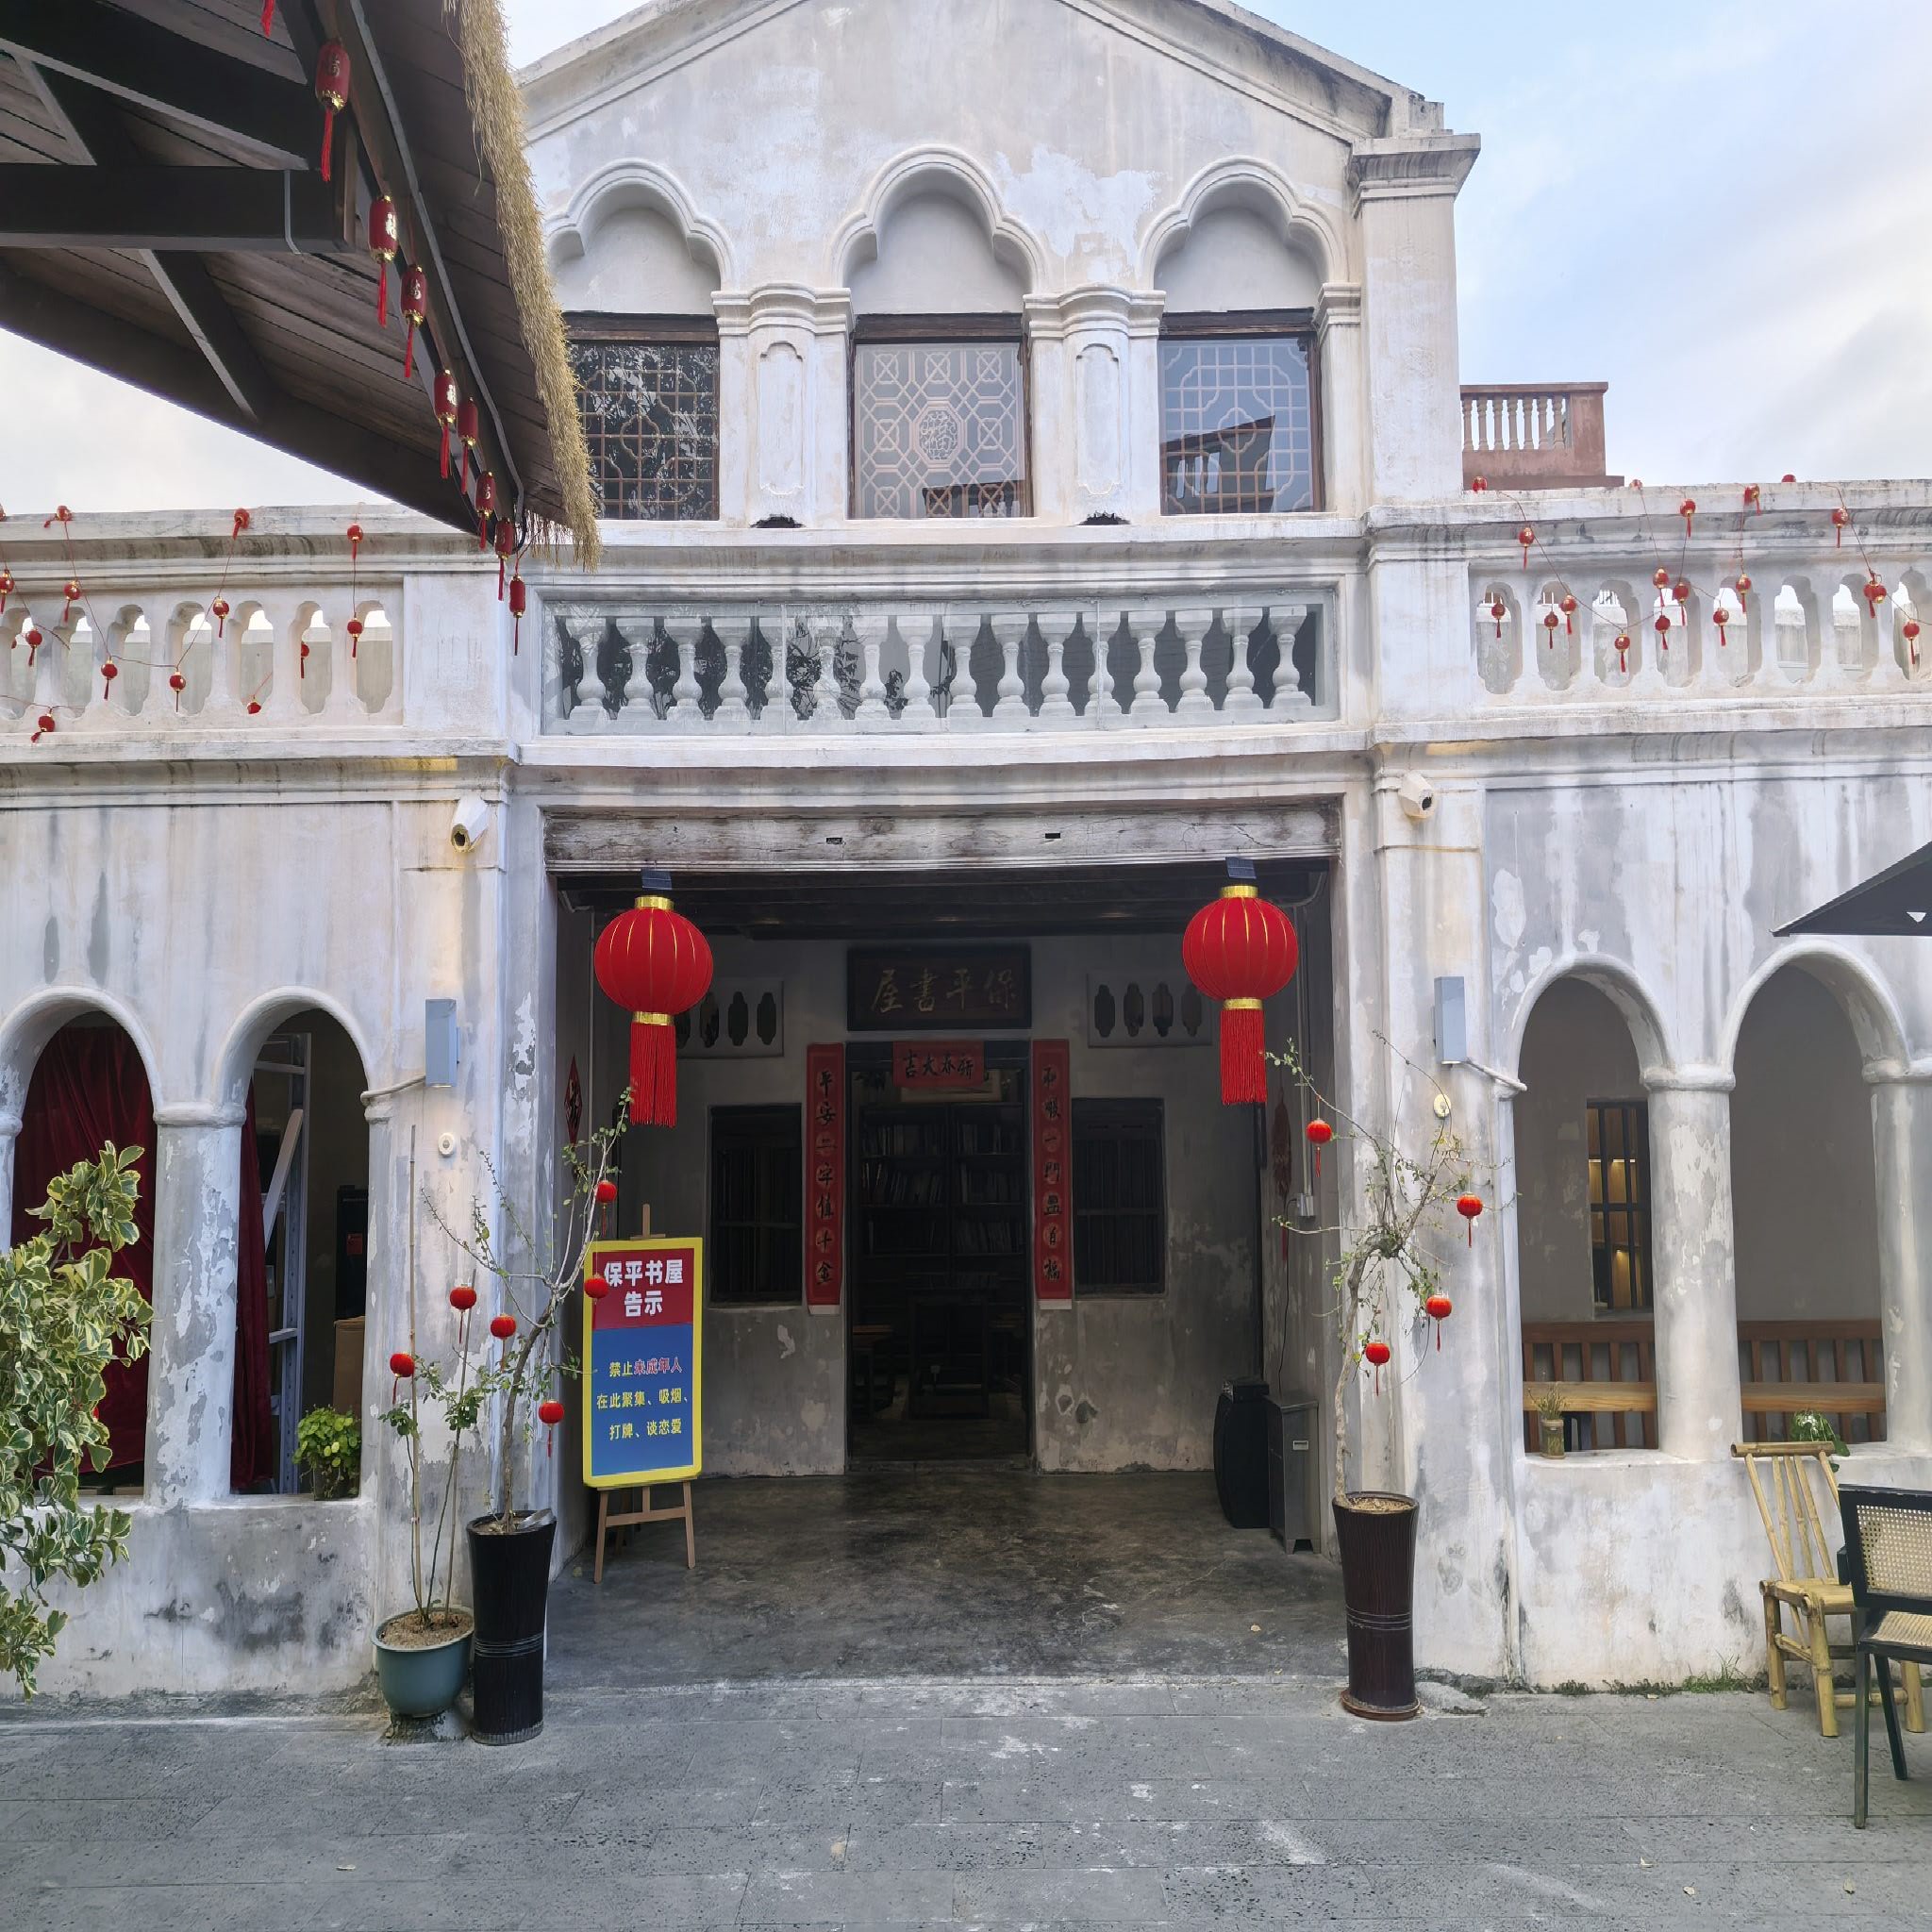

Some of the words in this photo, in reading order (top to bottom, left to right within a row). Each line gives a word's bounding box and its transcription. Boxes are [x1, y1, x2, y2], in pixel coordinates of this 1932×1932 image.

[604, 1259, 683, 1288] 保平书屋
[625, 1290, 663, 1317] 告示
[609, 1357, 683, 1377] 禁止未成年人
[608, 1418, 682, 1441] 打牌、谈恋爱
